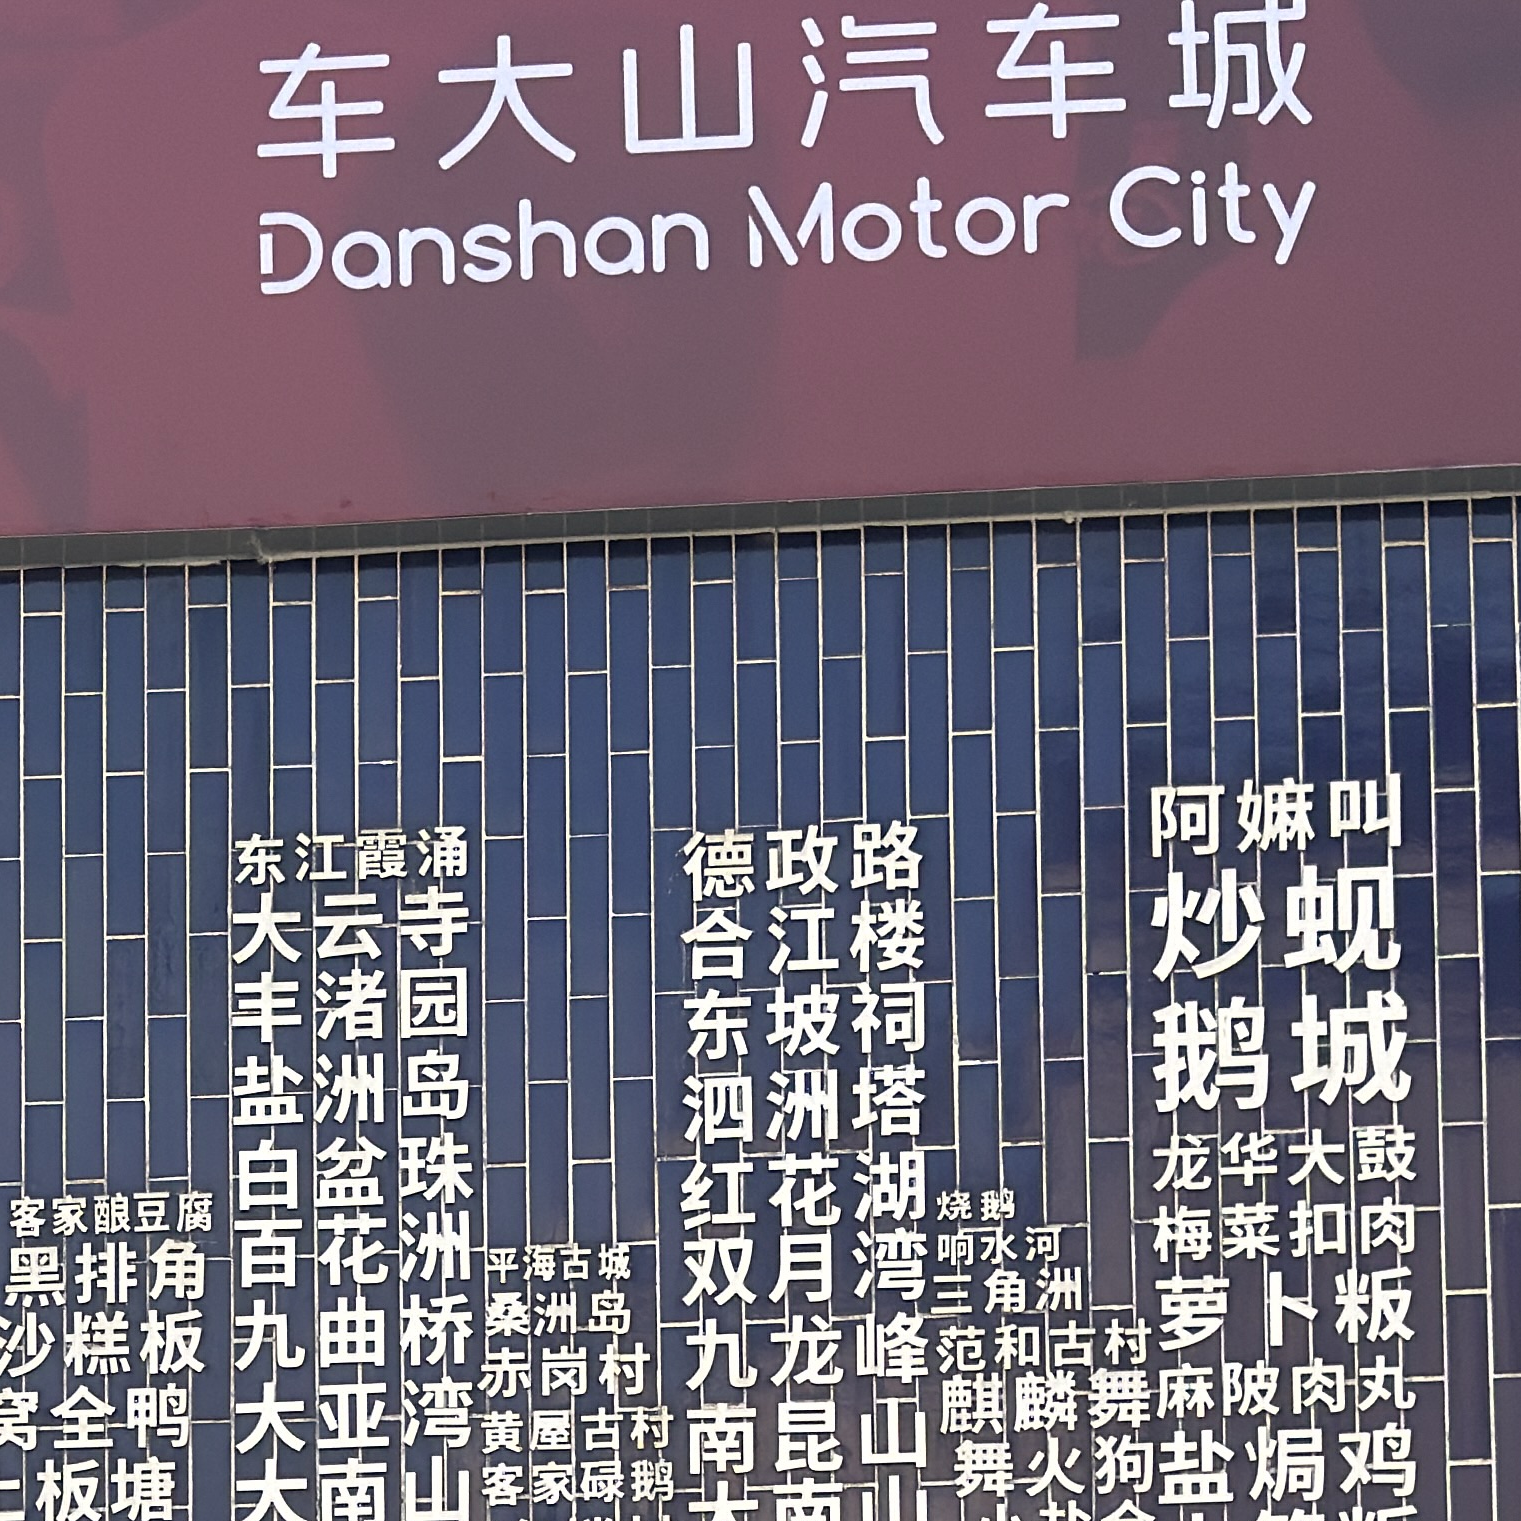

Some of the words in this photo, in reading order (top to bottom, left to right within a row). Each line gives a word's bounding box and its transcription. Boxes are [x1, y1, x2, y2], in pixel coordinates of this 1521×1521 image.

[257, 0, 1313, 178] 车大山汽车城
[260, 199, 710, 295] Danshan
[750, 178, 1069, 266] Motor
[1109, 162, 1315, 266] City
[1151, 773, 1401, 857] 阿嫲叫
[235, 827, 467, 885] 东江霞涌
[683, 820, 923, 901] 德政路
[232, 886, 469, 964] 大云寺
[681, 899, 925, 980] 合江楼
[1151, 865, 1401, 982] 炒蚬
[232, 968, 467, 1042] 丰渚园
[684, 982, 925, 1060] 东坡祠
[233, 1049, 469, 1126] 盐洲岛
[1152, 990, 1411, 1112] 鹅城
[683, 1064, 926, 1145] 泗洲塔
[238, 1132, 474, 1210] 白盆珠
[680, 1150, 926, 1230] 红花湖
[1152, 1125, 1417, 1191] 龙华大鼓
[10, 1191, 213, 1238] 客家酿豆腐
[936, 1188, 1015, 1221] 烧鹅
[1153, 1196, 1415, 1262] 梅菜扣肉
[5, 1239, 206, 1307] 黑排角
[234, 1210, 470, 1288] 百花洲
[487, 1243, 631, 1283] 平海古城
[682, 1227, 928, 1306] 双月湾
[937, 1226, 1061, 1265] 响水河
[485, 1290, 631, 1336] 桑洲岛
[931, 1267, 1082, 1315] 三角洲
[234, 1293, 474, 1371] 九曲桥
[477, 1342, 651, 1398] 赤岗村
[685, 1312, 928, 1391] 九龙峰
[936, 1318, 1151, 1373] 范和古村
[236, 1375, 474, 1454] 大亚湾
[940, 1367, 1150, 1434] 麒麟舞
[1157, 1355, 1417, 1418] 麻陂肉丸
[481, 1405, 674, 1454] 黄屋古村
[686, 1398, 926, 1475] 南昆山
[954, 1435, 1153, 1497] 舞火狗
[1159, 1422, 1416, 1504] 盐焗鸡
[482, 1459, 674, 1506] 客家碌鹅
